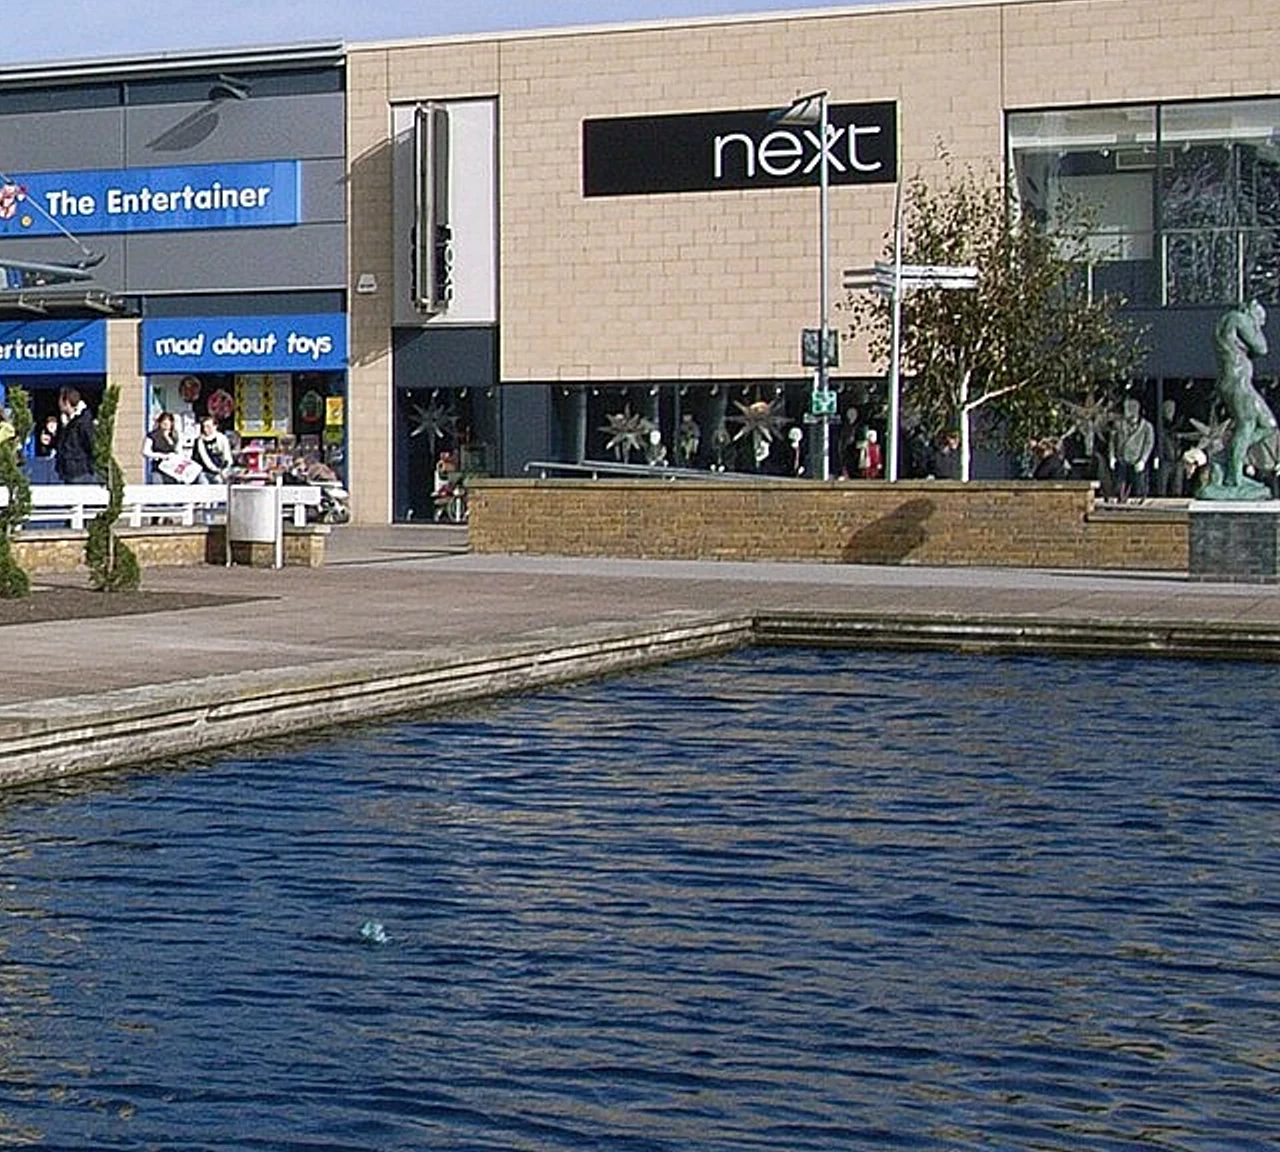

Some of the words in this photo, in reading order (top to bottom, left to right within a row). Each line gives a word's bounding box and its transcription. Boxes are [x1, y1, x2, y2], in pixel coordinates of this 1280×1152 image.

[713, 123, 883, 179] next
[45, 189, 96, 217] The
[106, 181, 272, 214] Entertainer
[155, 333, 204, 356] mad
[211, 332, 278, 356] about
[286, 332, 333, 361] toys
